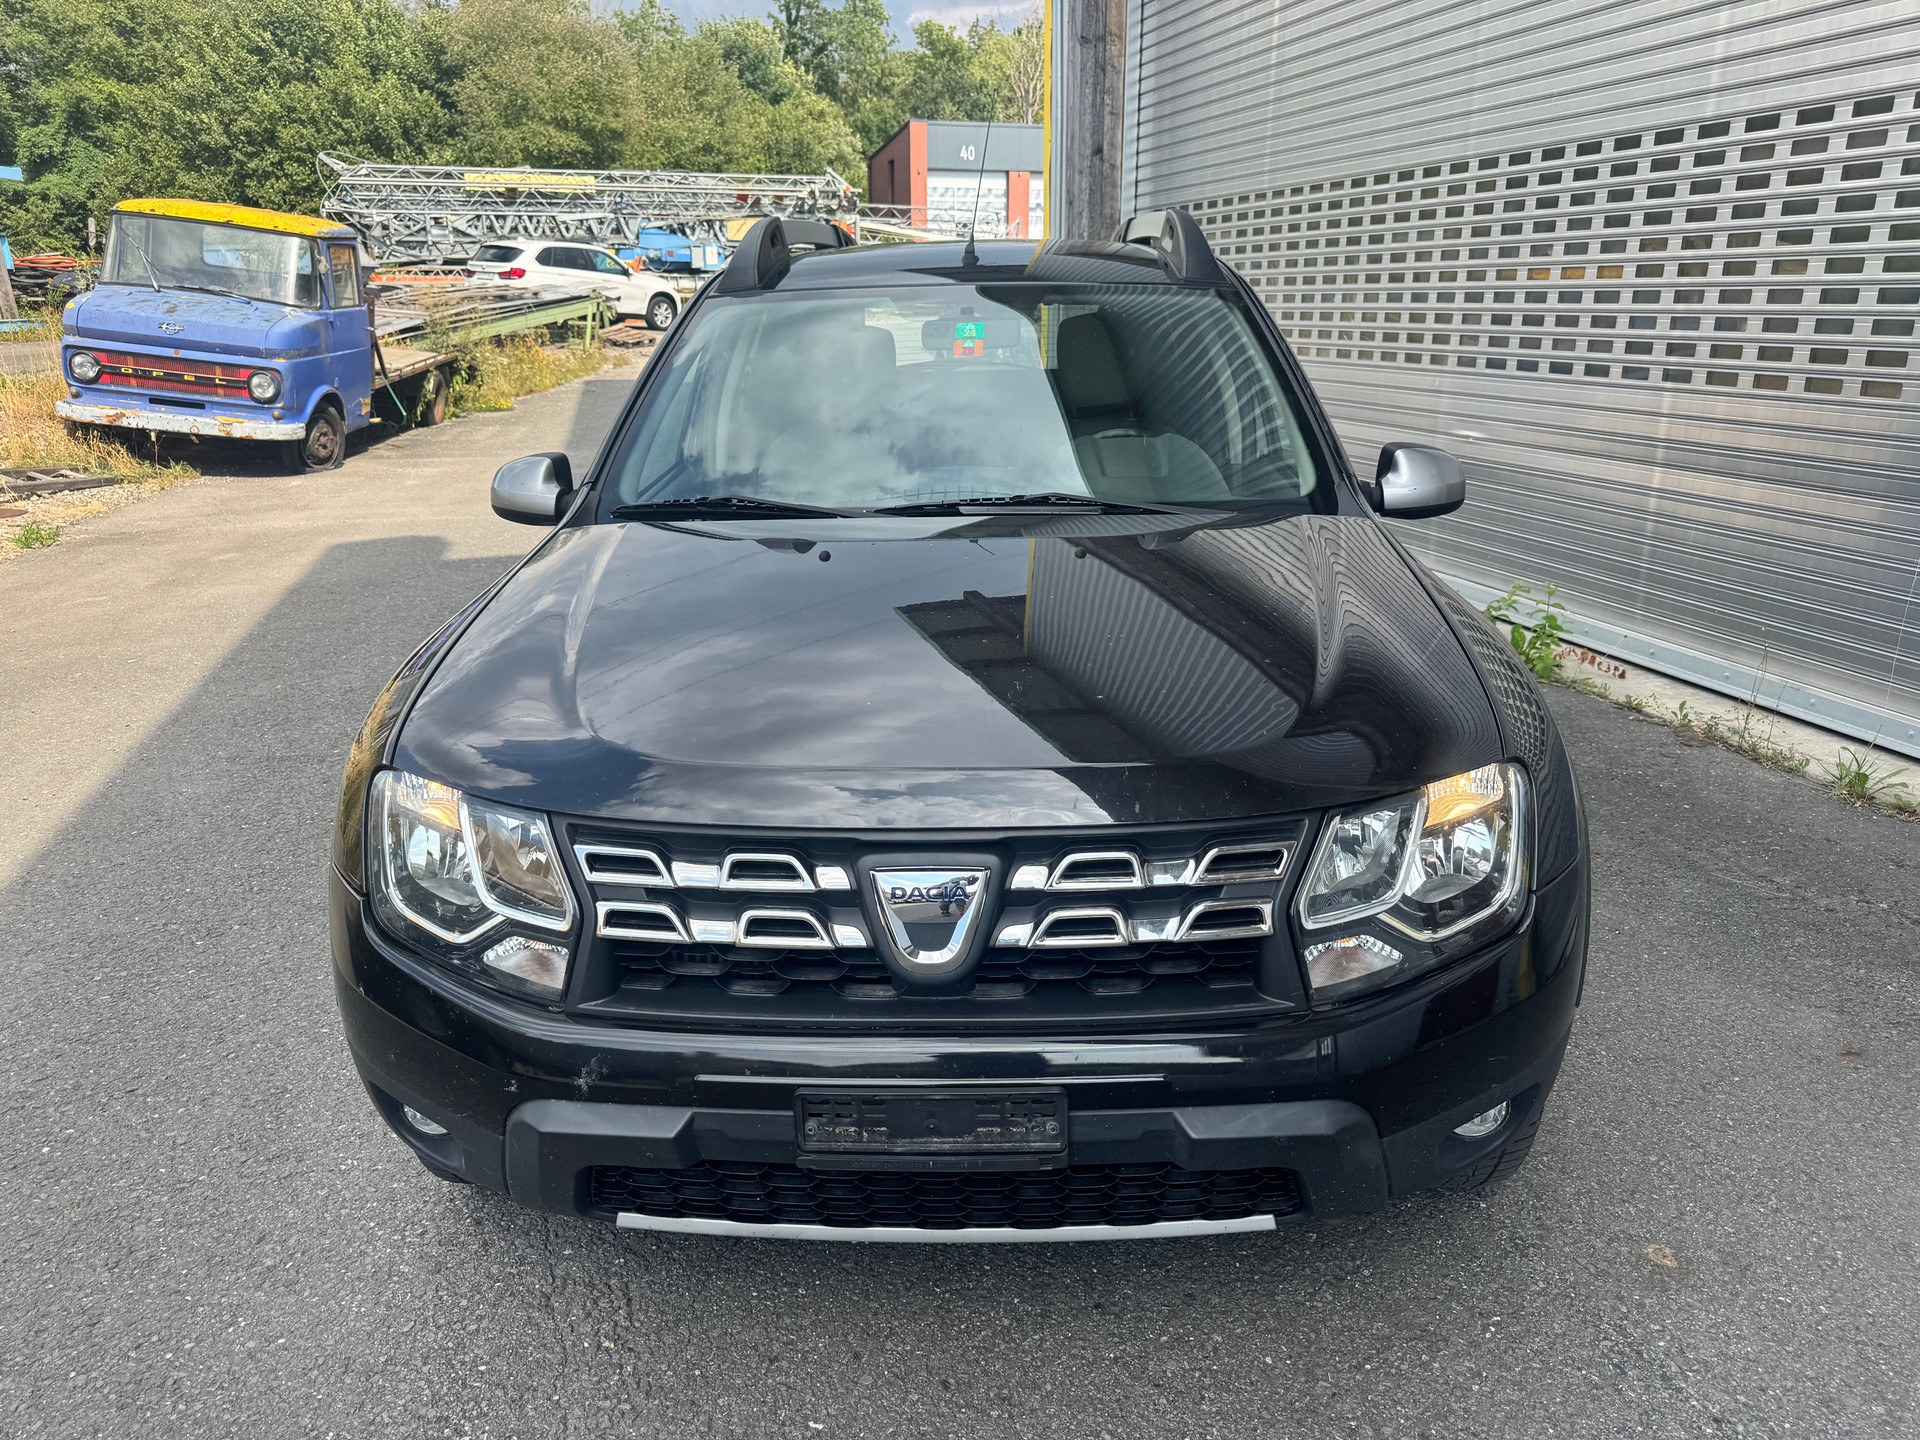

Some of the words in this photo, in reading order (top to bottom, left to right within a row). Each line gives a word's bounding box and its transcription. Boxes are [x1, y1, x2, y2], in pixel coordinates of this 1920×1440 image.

[960, 145, 975, 161] 40
[121, 367, 227, 384] OPEL
[890, 885, 970, 901] DACIA
